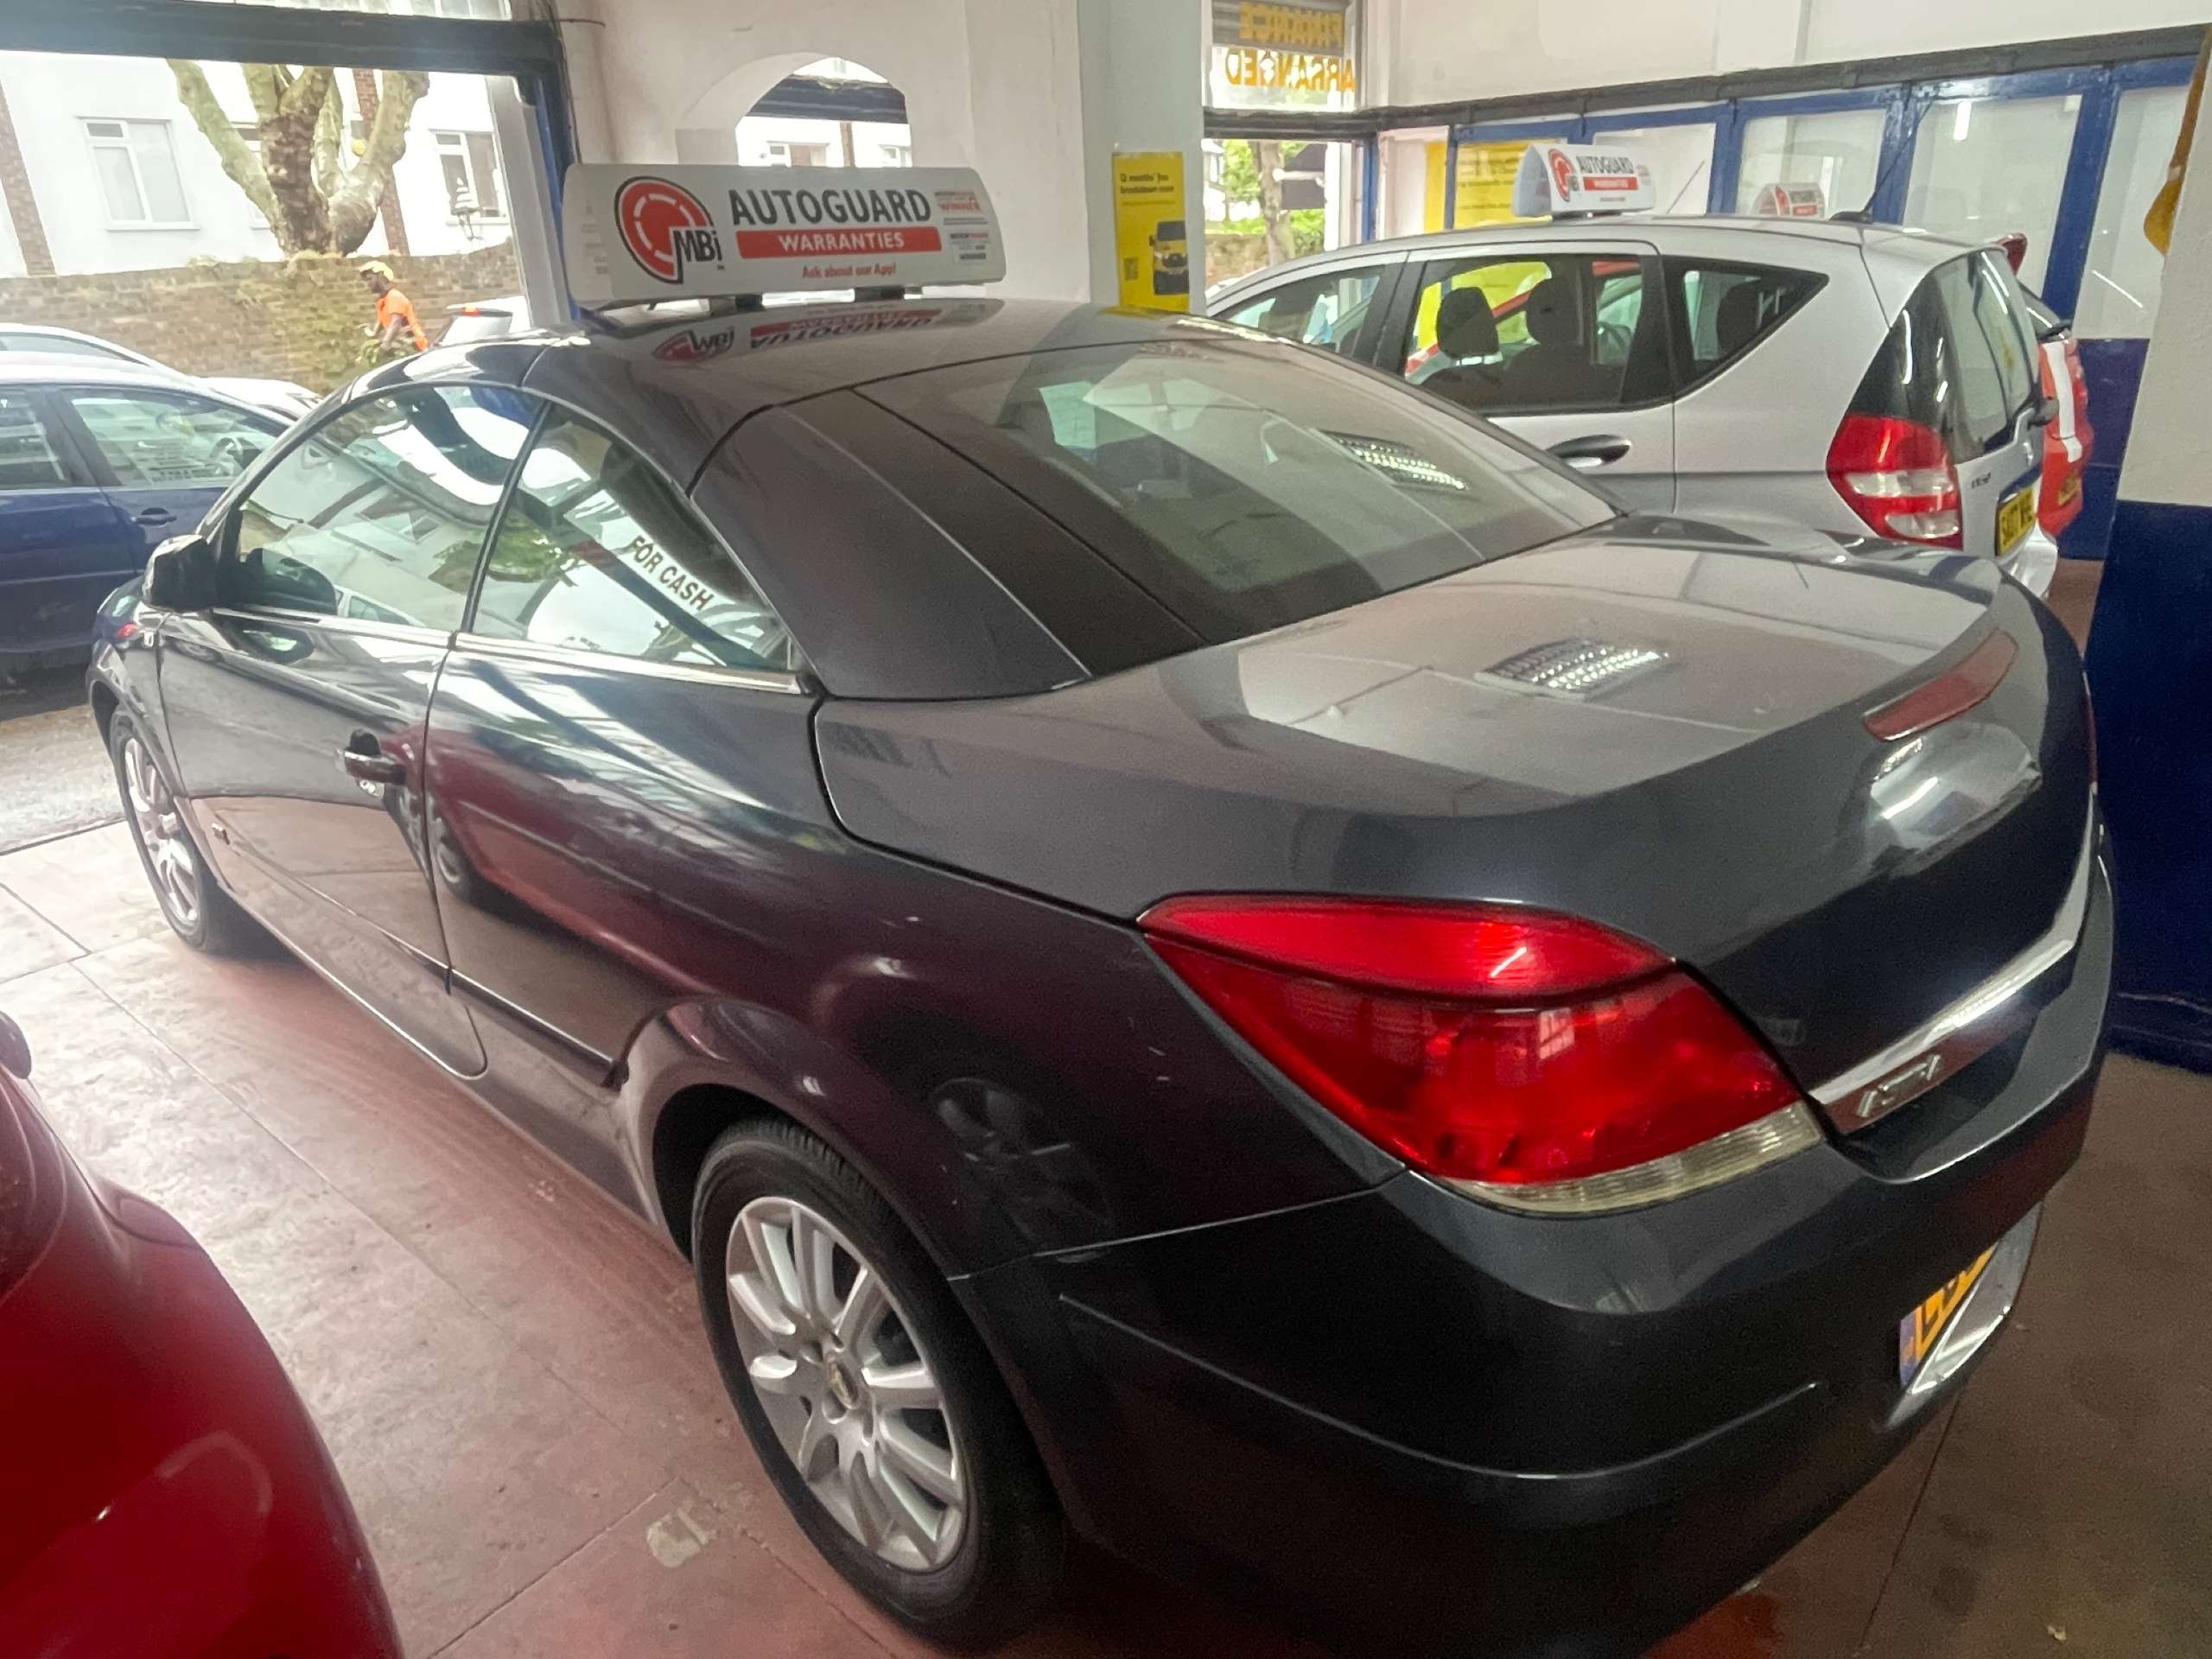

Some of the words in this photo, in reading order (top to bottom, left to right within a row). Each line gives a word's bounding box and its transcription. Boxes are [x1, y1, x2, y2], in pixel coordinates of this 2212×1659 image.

[728, 188, 931, 226] AUTOGUARD
[779, 232, 906, 251] WARRANTIES
[802, 265, 821, 277] Ask
[824, 264, 853, 276] about
[631, 535, 664, 574] FOR
[659, 566, 715, 611] CASH
